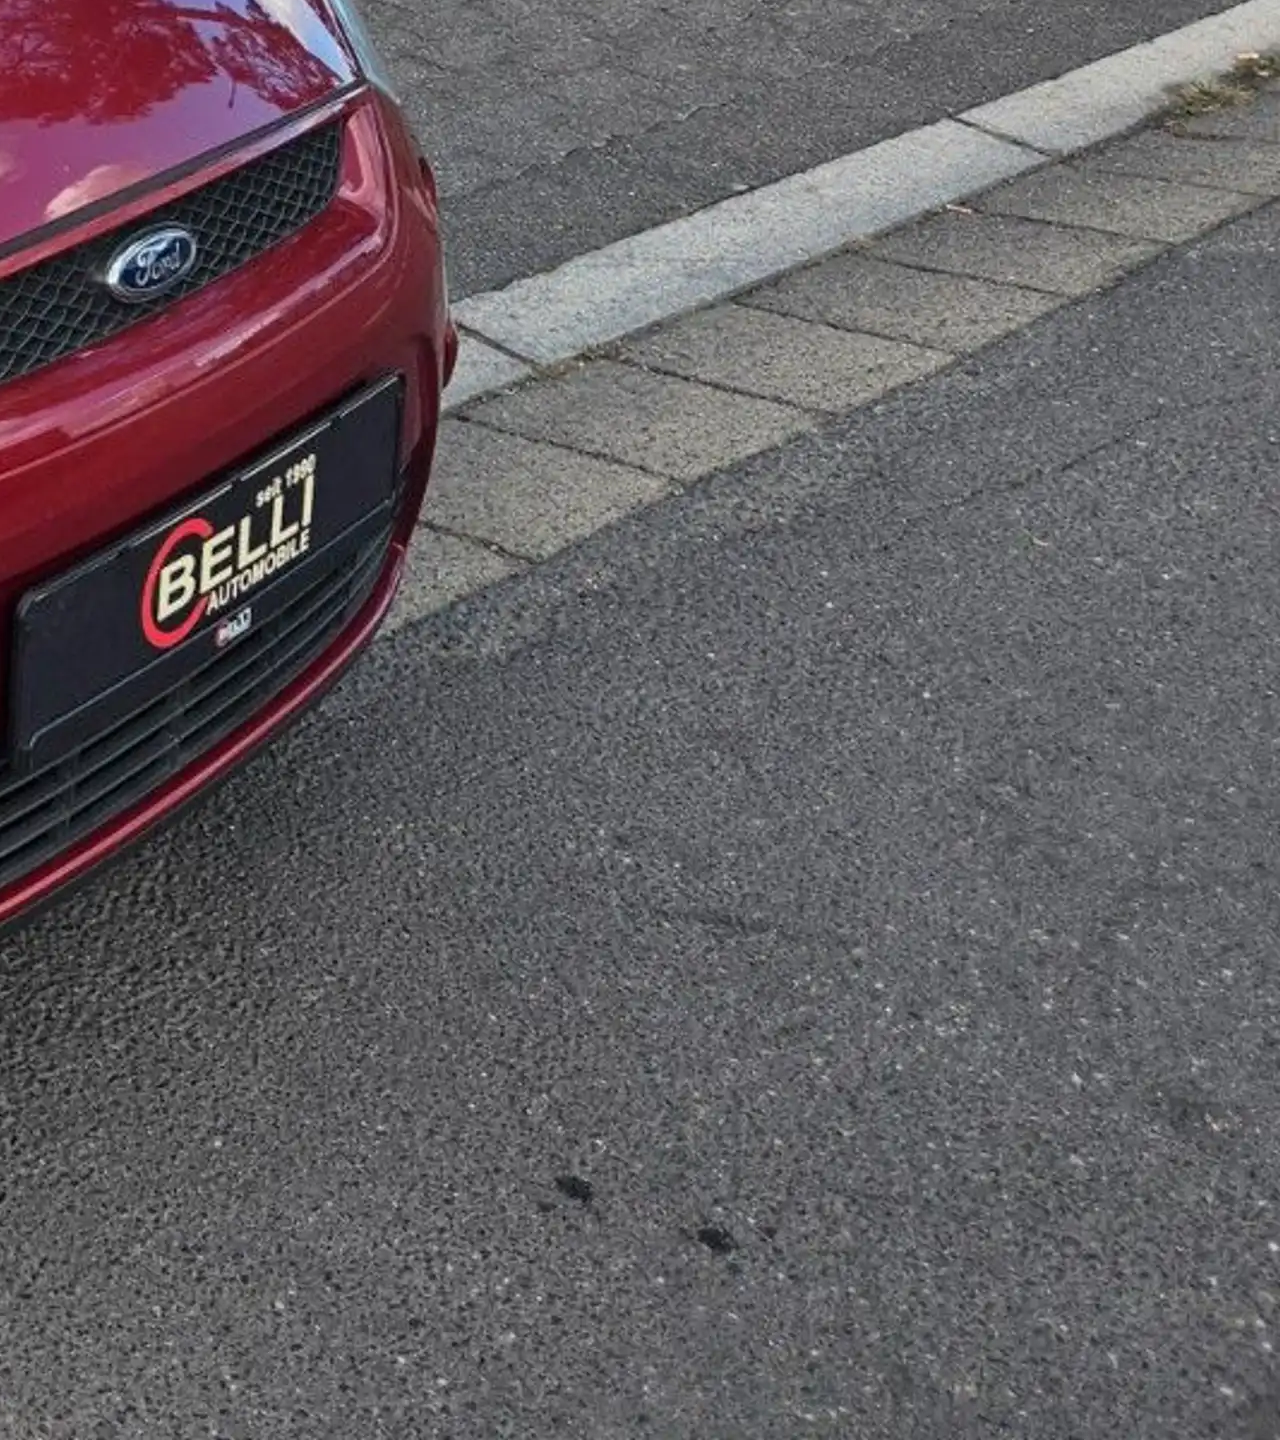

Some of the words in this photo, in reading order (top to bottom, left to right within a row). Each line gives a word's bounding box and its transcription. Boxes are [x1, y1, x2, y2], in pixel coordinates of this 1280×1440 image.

[135, 235, 181, 287] Ford
[255, 475, 283, 508] seit
[156, 473, 315, 622] BELLI
[205, 529, 311, 616] AUTOMOBILE
